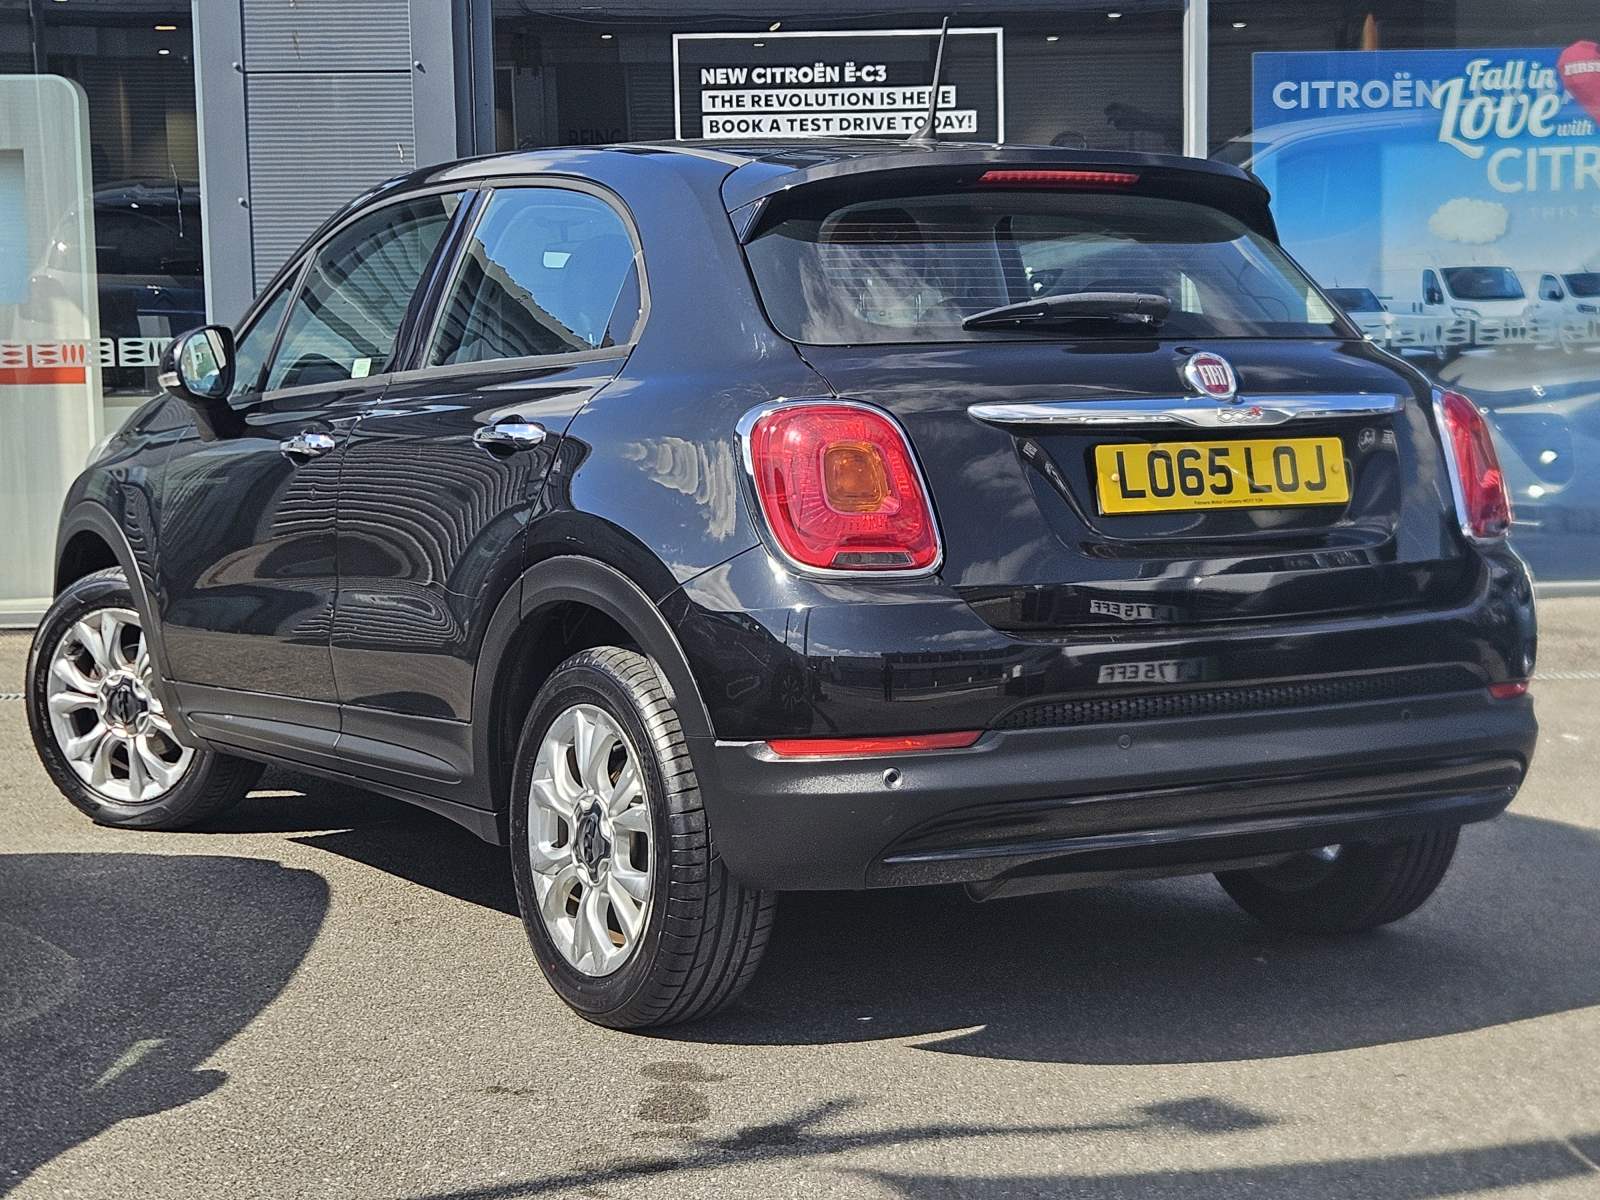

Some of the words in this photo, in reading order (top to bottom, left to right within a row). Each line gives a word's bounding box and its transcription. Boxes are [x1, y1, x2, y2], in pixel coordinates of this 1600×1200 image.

[701, 68, 747, 84] NEW
[751, 63, 839, 84] CITROËN
[844, 62, 887, 82] Ë-C3
[1466, 59, 1525, 91] Fall
[1528, 62, 1555, 89] in
[708, 94, 746, 108] THE
[750, 92, 875, 108] REVOLUTION
[880, 91, 897, 105] IS
[902, 90, 951, 105] HEE
[1272, 72, 1441, 110] CITROËN
[709, 119, 763, 134] BOOK
[769, 118, 781, 132] A
[786, 117, 833, 132] TEST
[839, 115, 896, 130] DRIVE
[1432, 77, 1561, 160] Love
[1557, 121, 1593, 137] with
[1197, 364, 1228, 386] FIAT
[1116, 449, 1234, 499] LO65
[1244, 444, 1327, 494] LOJ
